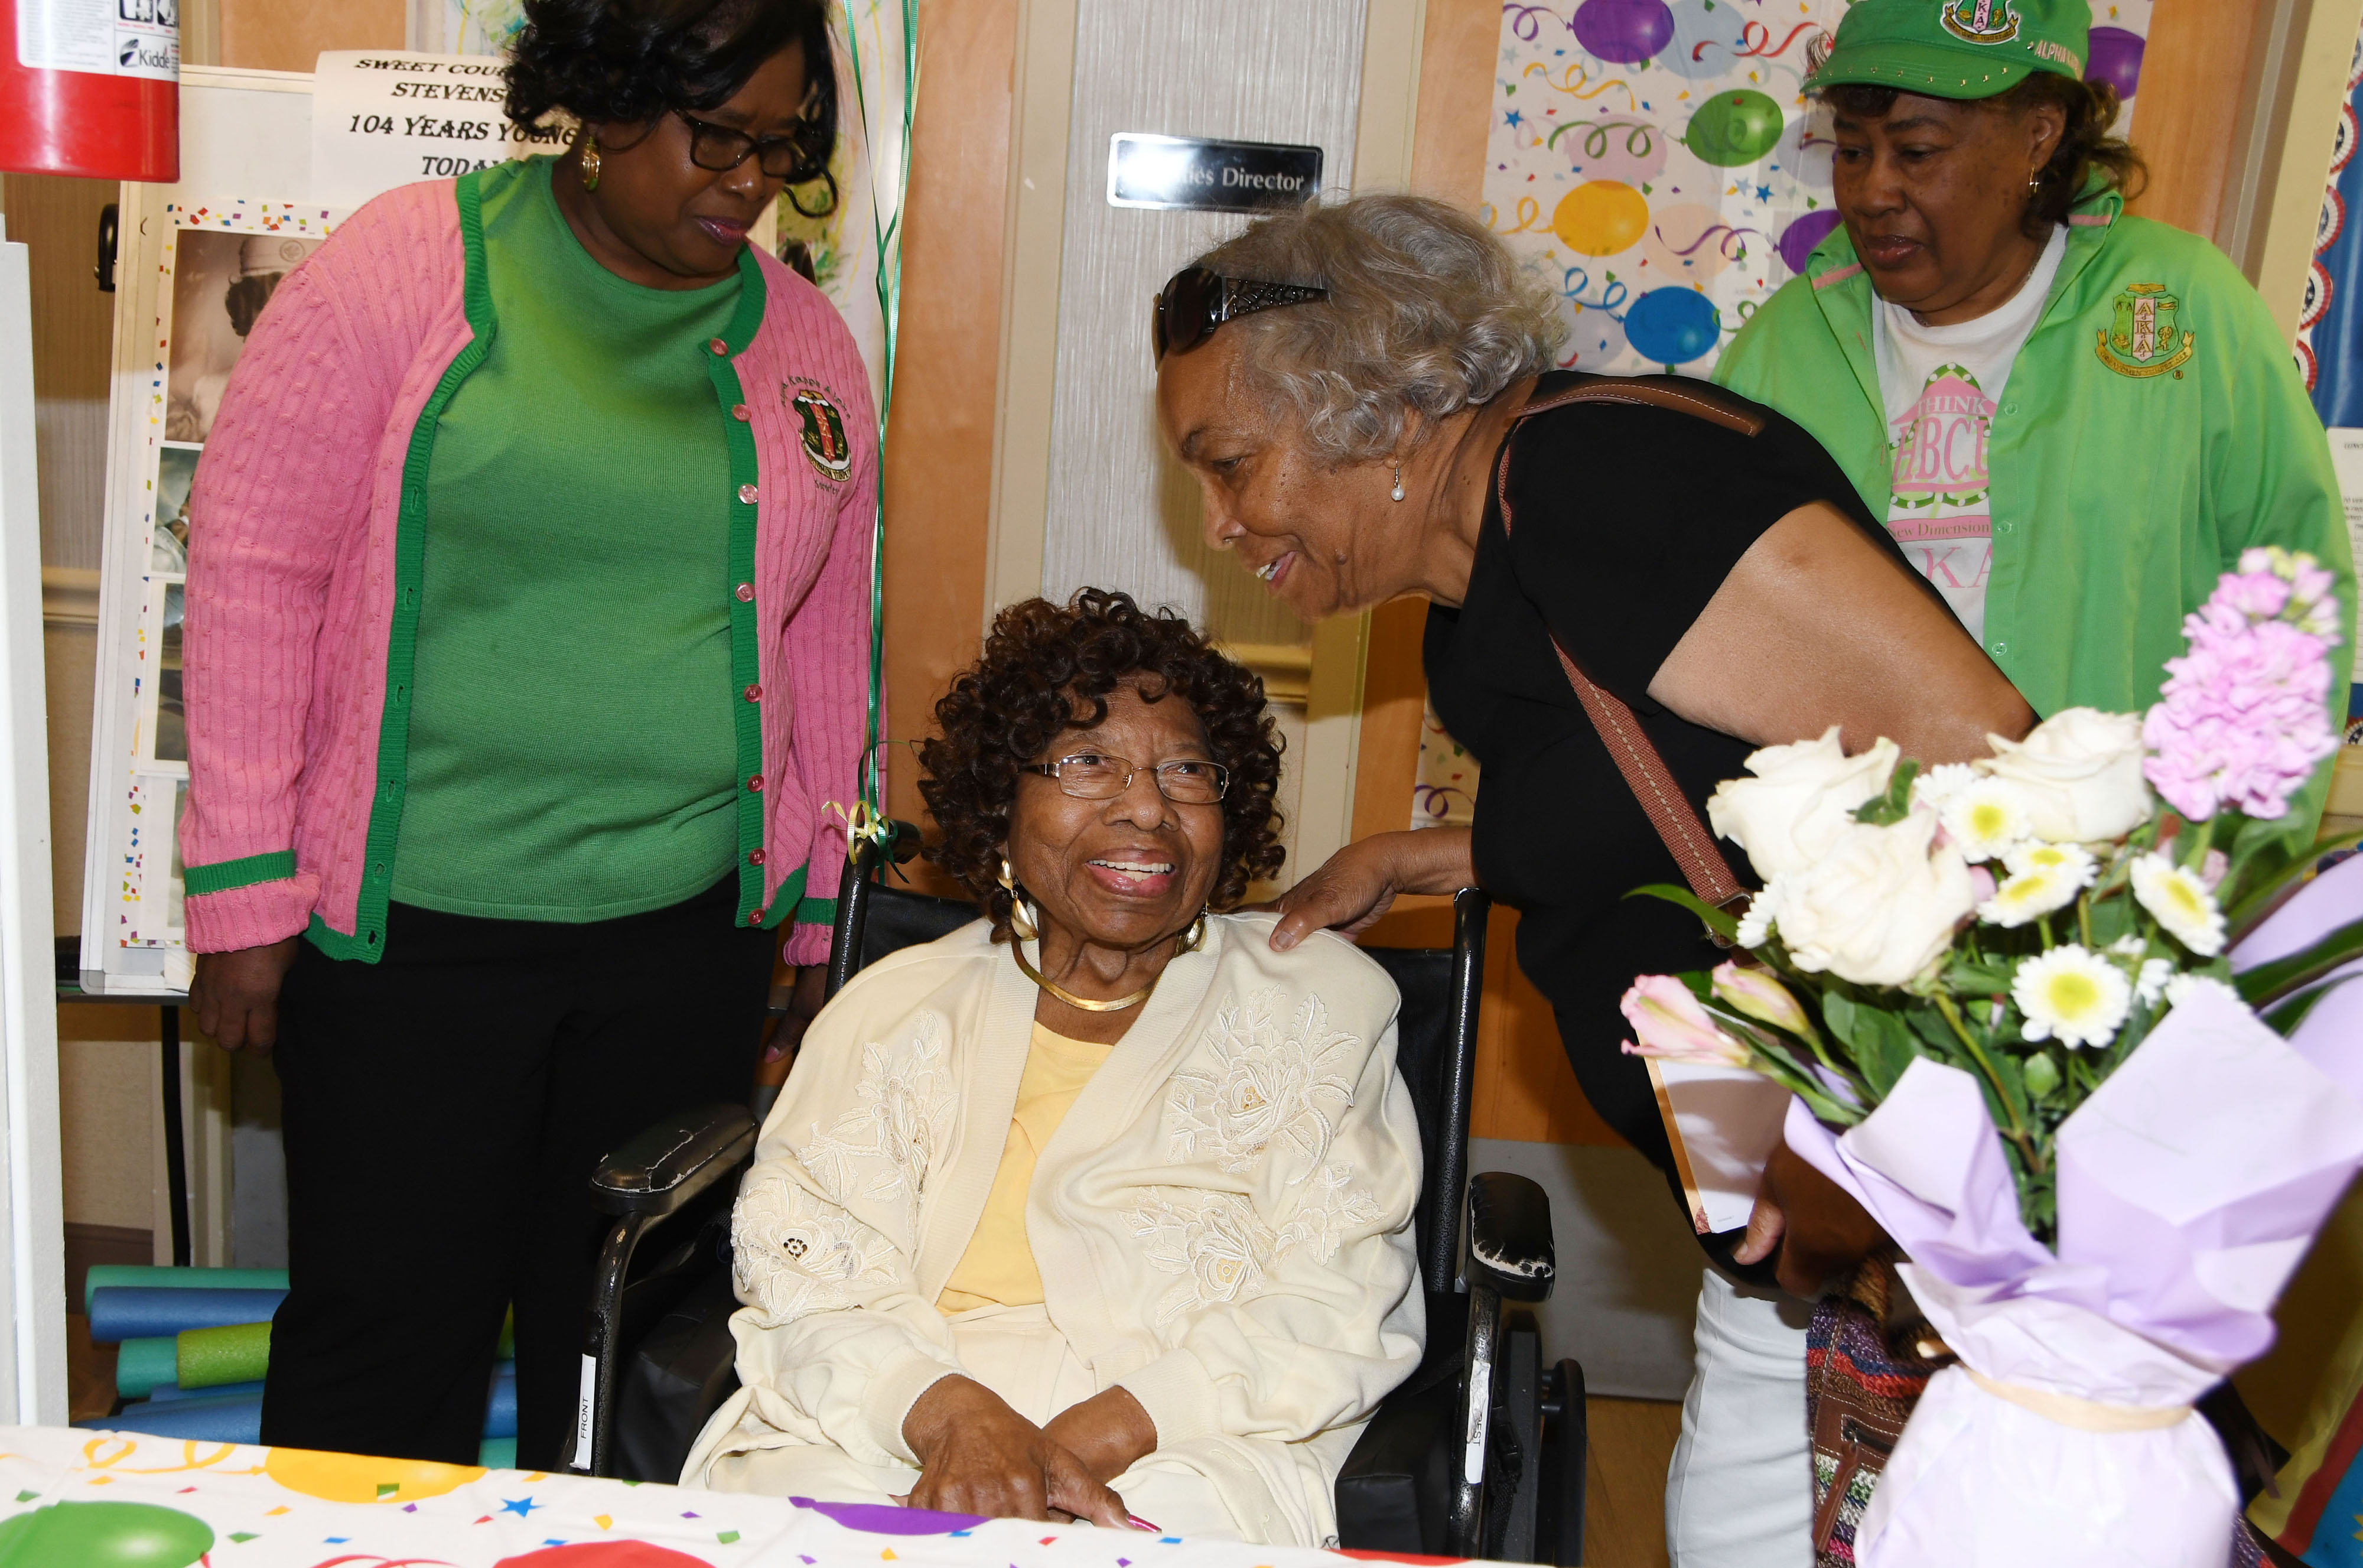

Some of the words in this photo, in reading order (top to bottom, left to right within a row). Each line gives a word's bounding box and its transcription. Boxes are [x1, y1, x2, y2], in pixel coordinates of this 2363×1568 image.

[139, 49, 170, 69] Kidde
[354, 58, 444, 72] SWEET
[349, 115, 394, 135] 104
[404, 114, 490, 141] YEARS
[497, 122, 578, 145] YOUNG
[422, 155, 502, 177] TODA
[1222, 166, 1304, 191] Director
[1916, 395, 1988, 415] THINK
